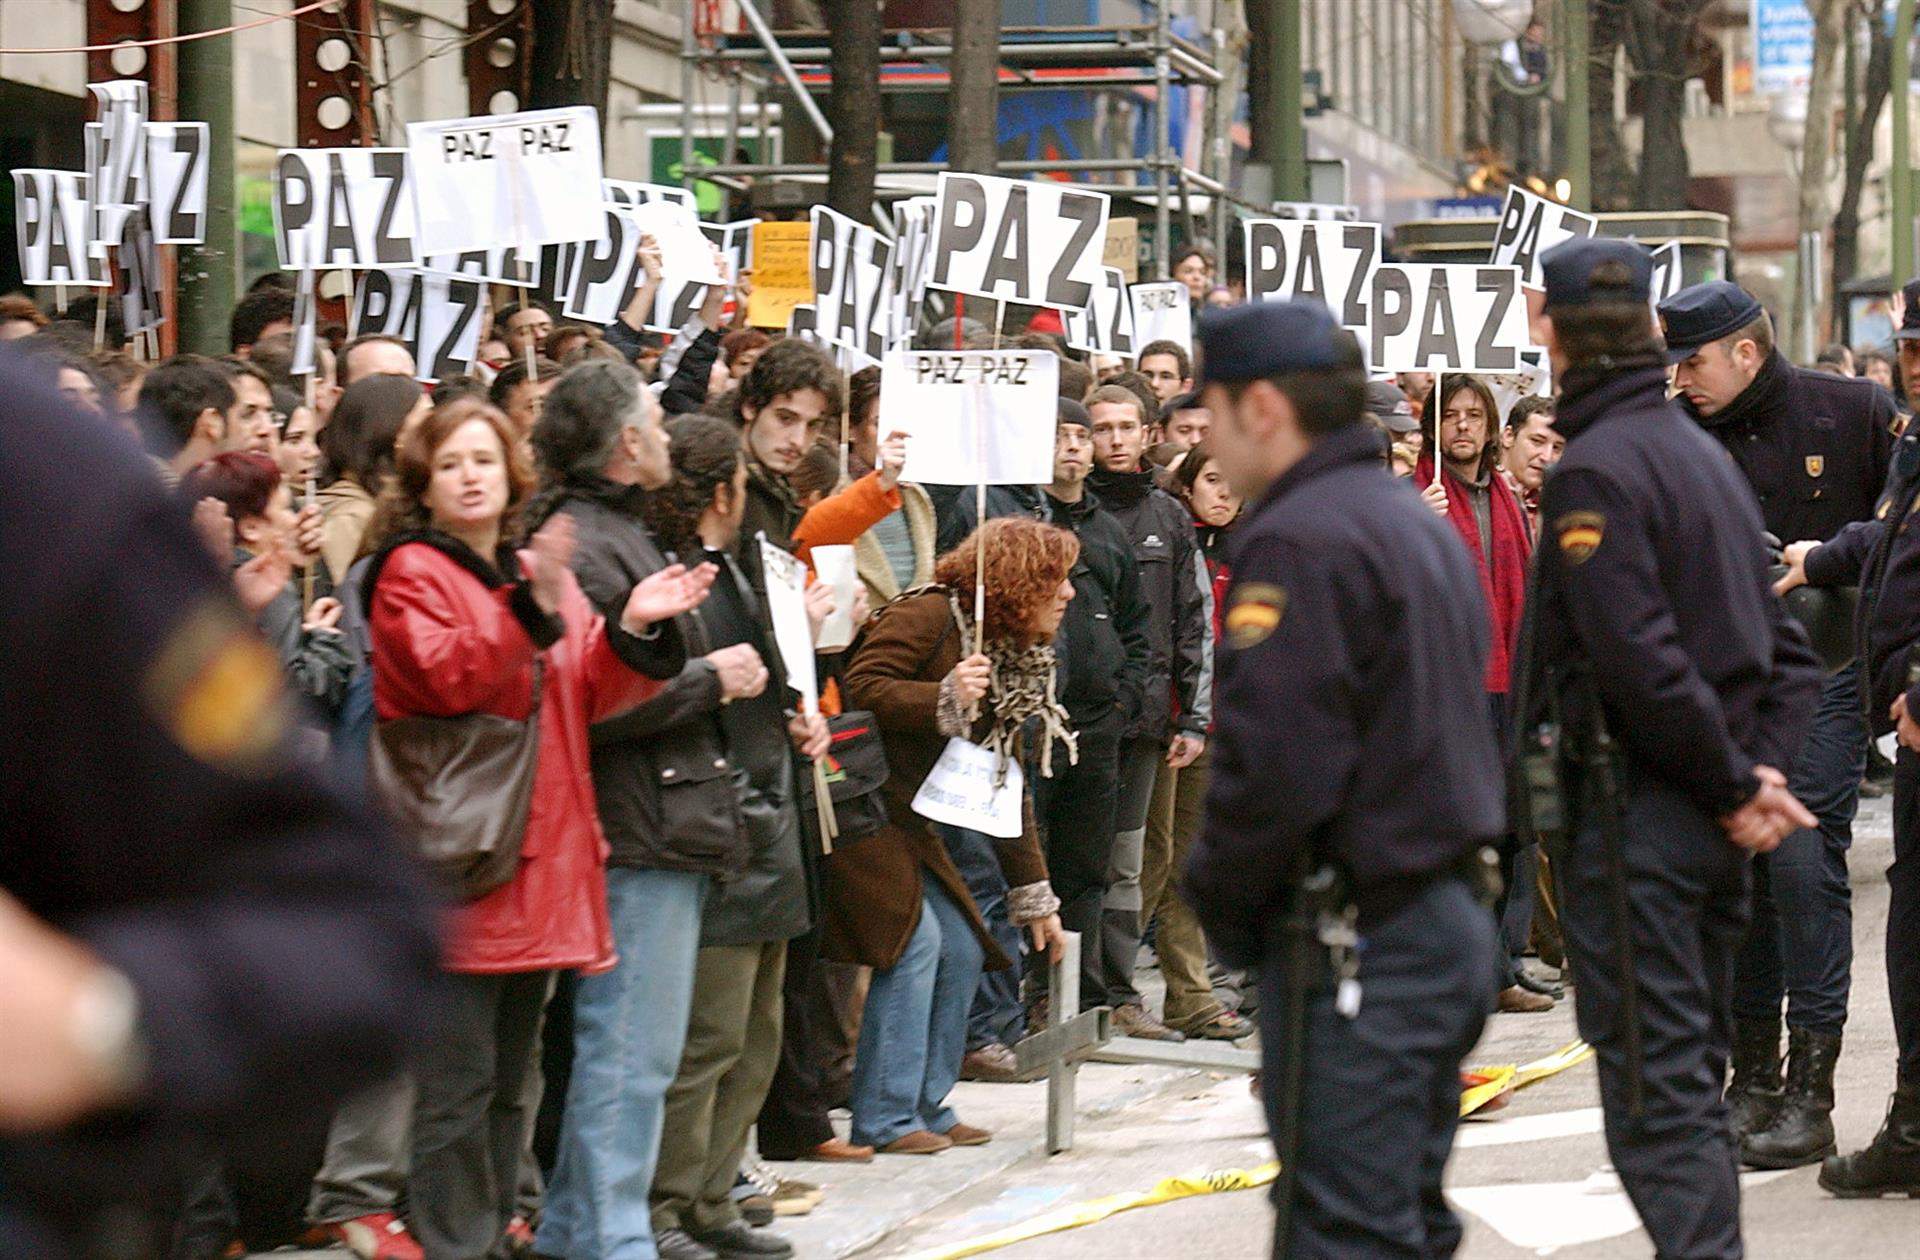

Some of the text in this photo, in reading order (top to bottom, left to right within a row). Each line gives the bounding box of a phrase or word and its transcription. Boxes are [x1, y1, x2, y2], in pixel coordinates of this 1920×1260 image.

[443, 124, 571, 163] PAZ PAZ
[280, 153, 413, 264] PAZ
[934, 177, 1103, 307] PAZ
[357, 270, 480, 378] PAZ
[815, 211, 889, 361] PAZ
[1251, 224, 1375, 326] PAZ
[1372, 268, 1515, 368] PAZ
[917, 356, 1028, 385] PAZ PAZ
